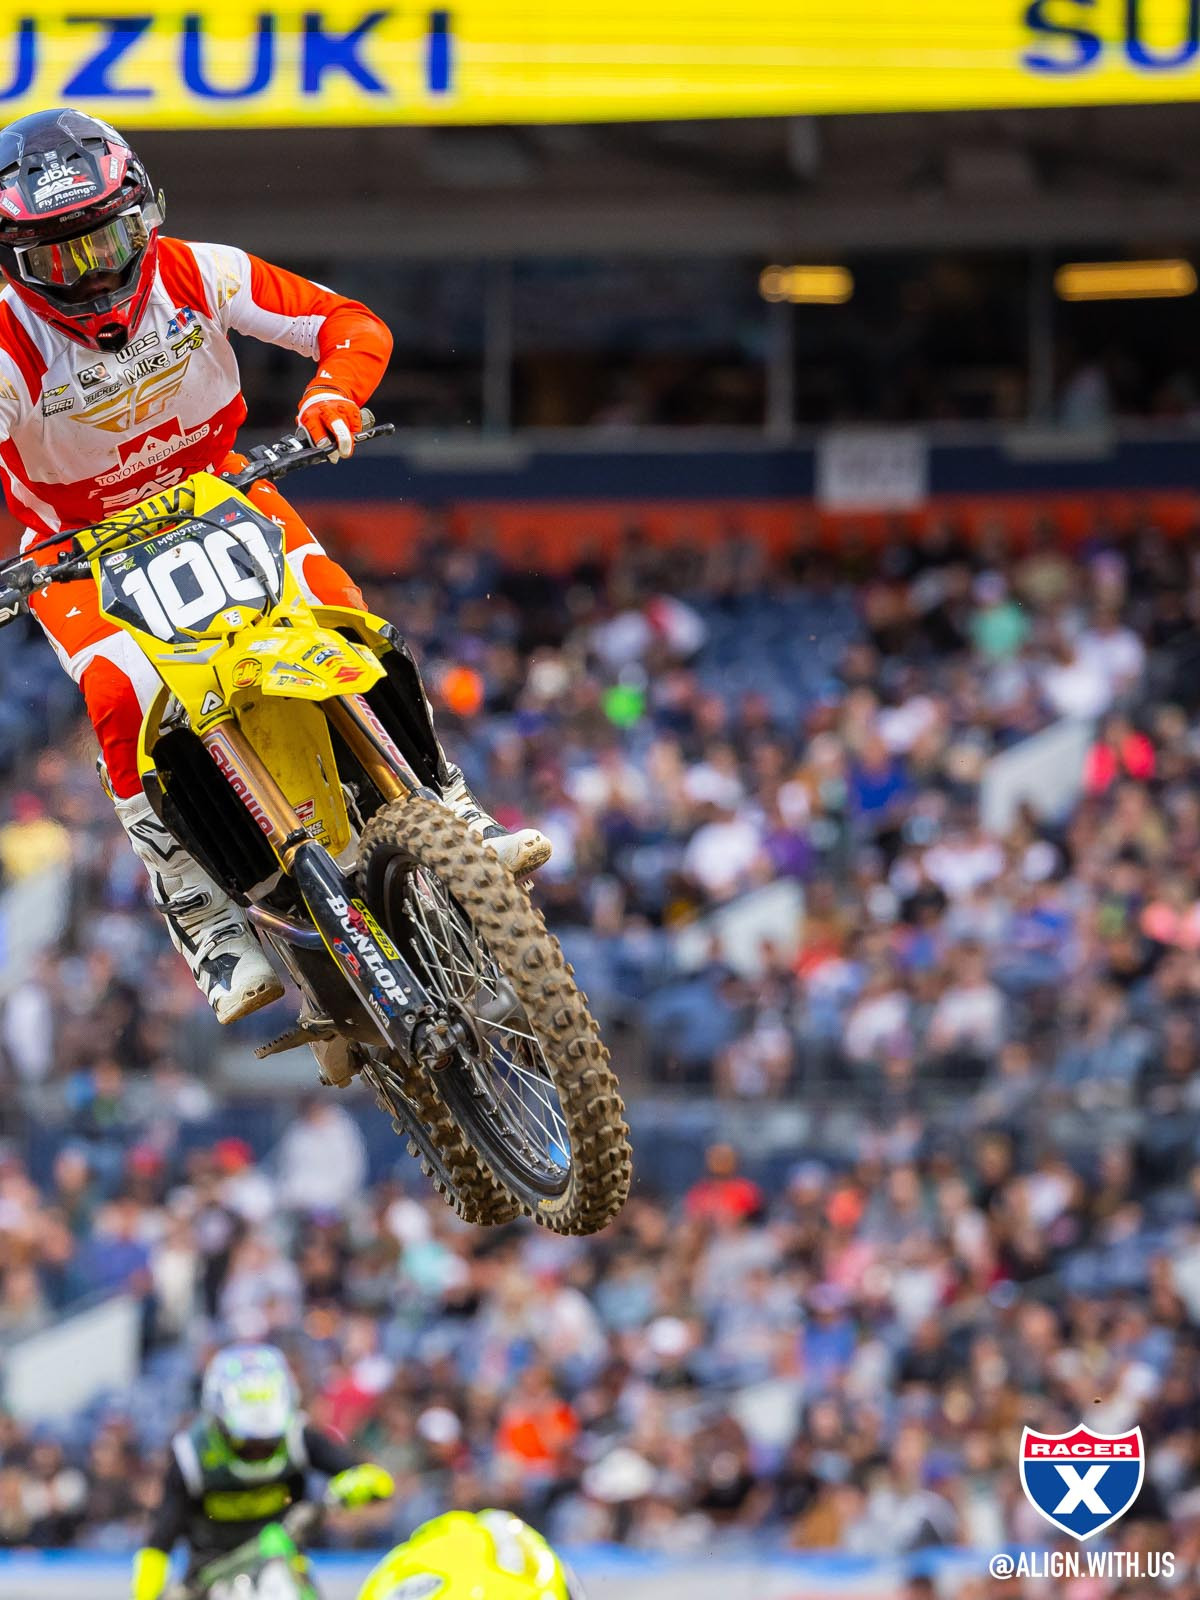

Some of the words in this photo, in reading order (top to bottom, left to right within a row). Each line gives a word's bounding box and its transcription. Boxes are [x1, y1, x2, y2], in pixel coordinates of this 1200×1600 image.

[38, 196, 54, 209] Fly
[115, 331, 160, 364] WPS
[85, 382, 122, 406] TUCKER
[99, 461, 145, 486] TOYOTA
[147, 424, 210, 465] REDLANDS
[147, 442, 157, 451] R
[156, 522, 208, 546] MONSTER
[121, 521, 281, 642] 100
[326, 894, 409, 1006] DUNLOP
